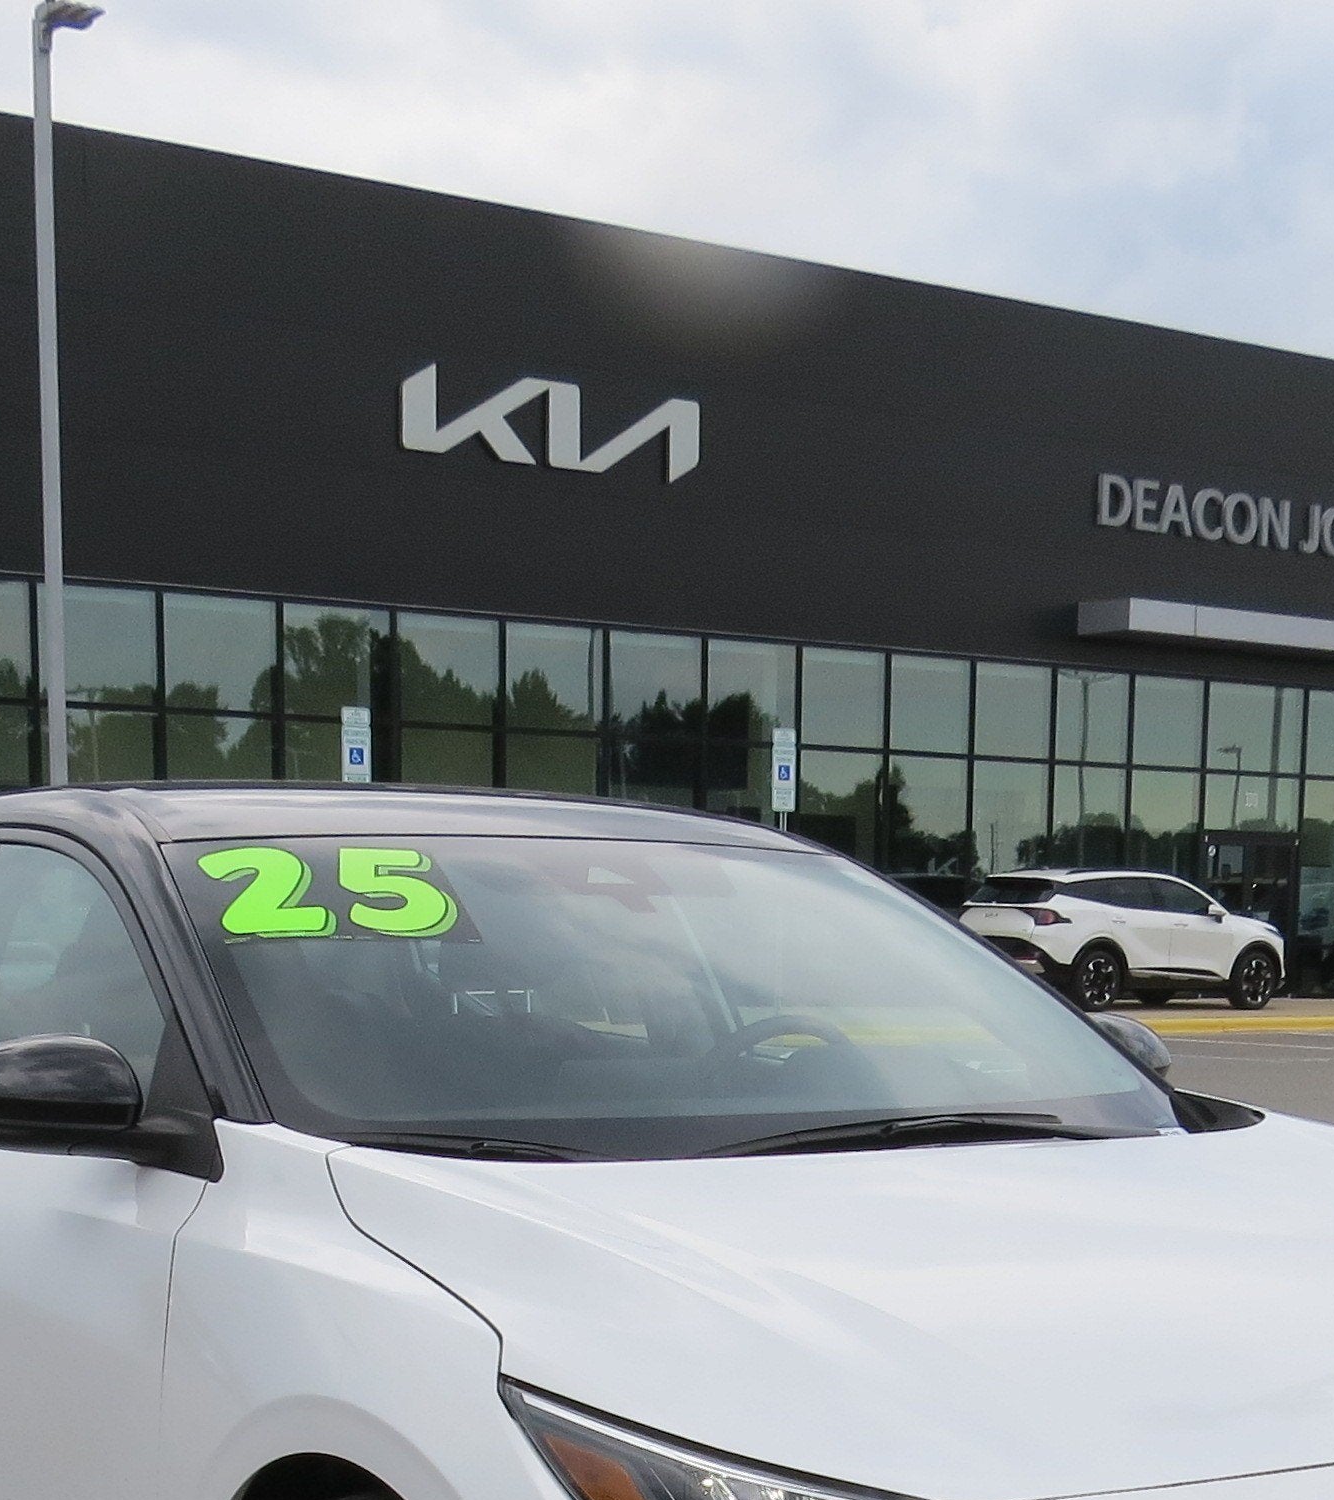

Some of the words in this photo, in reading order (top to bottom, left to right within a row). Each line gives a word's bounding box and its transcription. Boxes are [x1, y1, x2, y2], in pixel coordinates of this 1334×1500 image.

[401, 363, 700, 483] KIA
[1097, 472, 1291, 550] DEACON
[197, 846, 458, 938] 25
